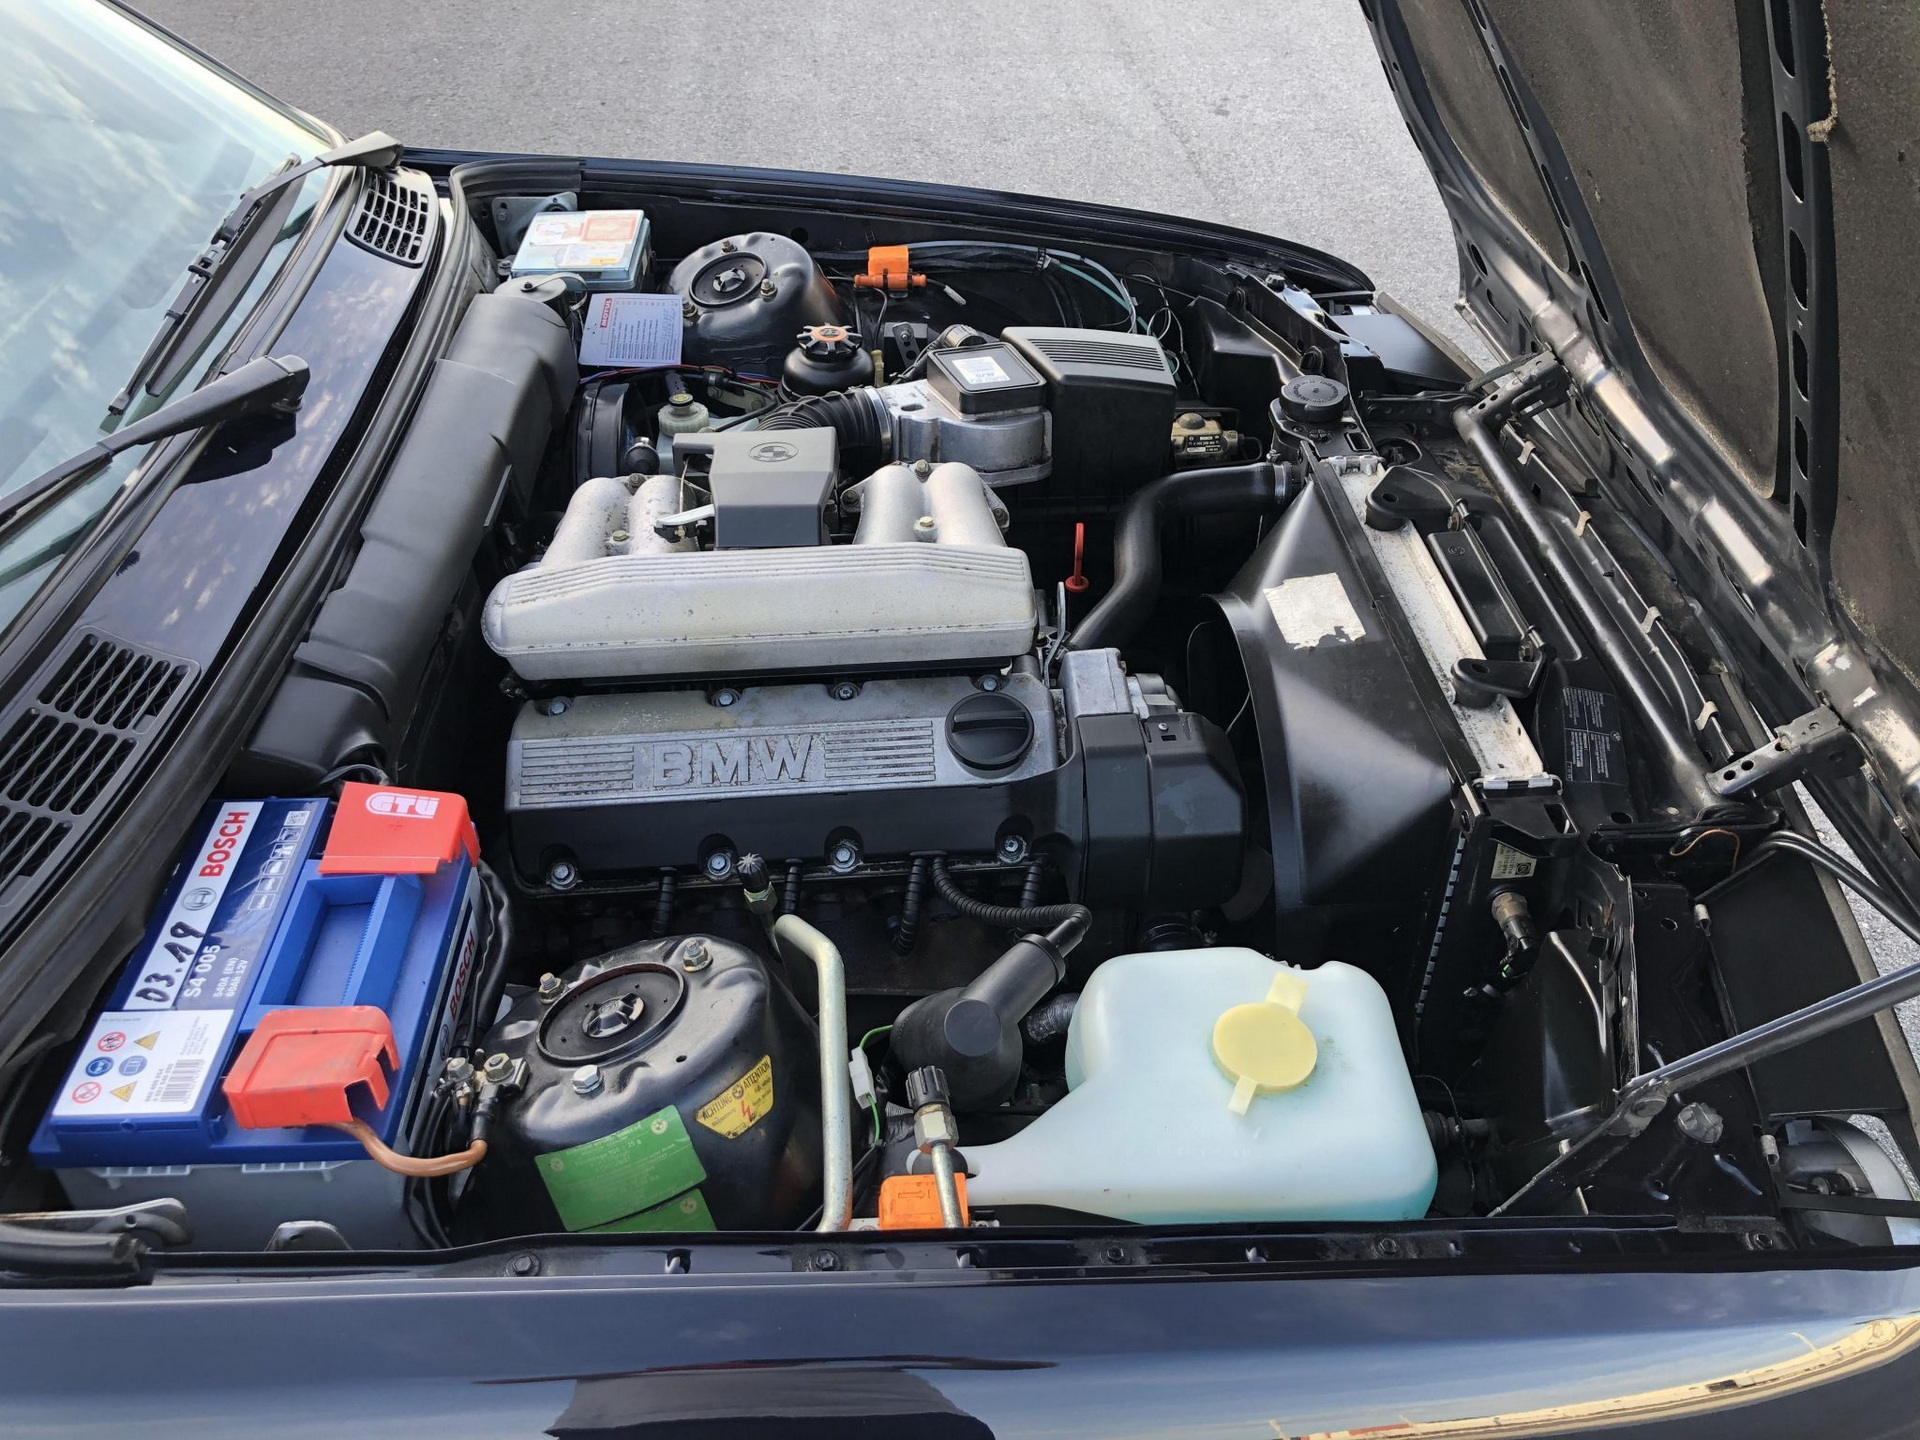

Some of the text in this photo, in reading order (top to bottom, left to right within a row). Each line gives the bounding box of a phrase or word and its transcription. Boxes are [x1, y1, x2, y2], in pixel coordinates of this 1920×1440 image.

[600, 298, 612, 328] MOTUL
[653, 733, 813, 787] BMW
[199, 812, 250, 877] BOSCH
[183, 977, 207, 997] S4
[195, 945, 221, 973] 005
[450, 931, 475, 1021] BOSCH
[743, 1060, 771, 1090] ATTENTION
[702, 1093, 733, 1120] ACHTUNG
